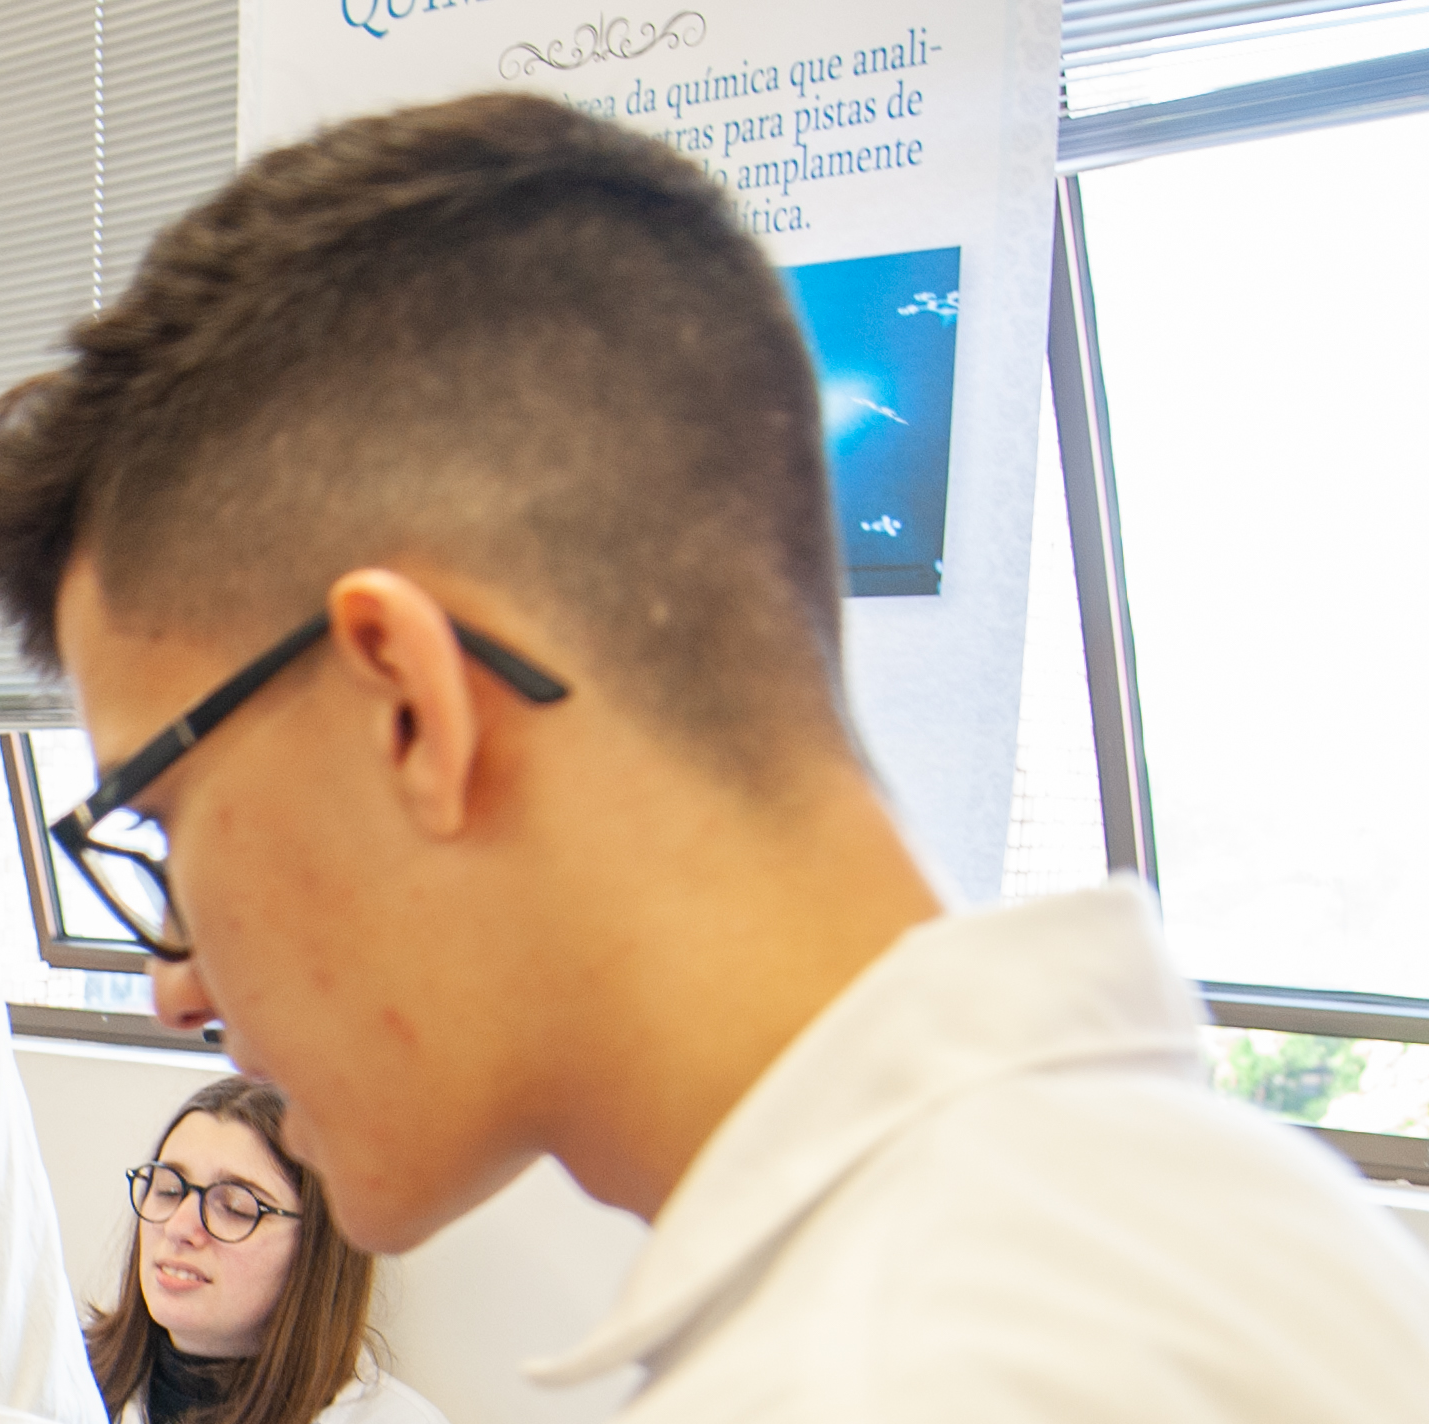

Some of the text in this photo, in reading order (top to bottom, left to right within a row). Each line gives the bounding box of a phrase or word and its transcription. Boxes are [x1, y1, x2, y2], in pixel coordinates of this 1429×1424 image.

[625, 78, 657, 116] da
[666, 59, 779, 119] química
[790, 54, 843, 98] que
[853, 27, 943, 76] anali-
[723, 112, 784, 158] para
[794, 94, 877, 147] pistas
[887, 78, 924, 120] de
[737, 137, 924, 197] amplamente
